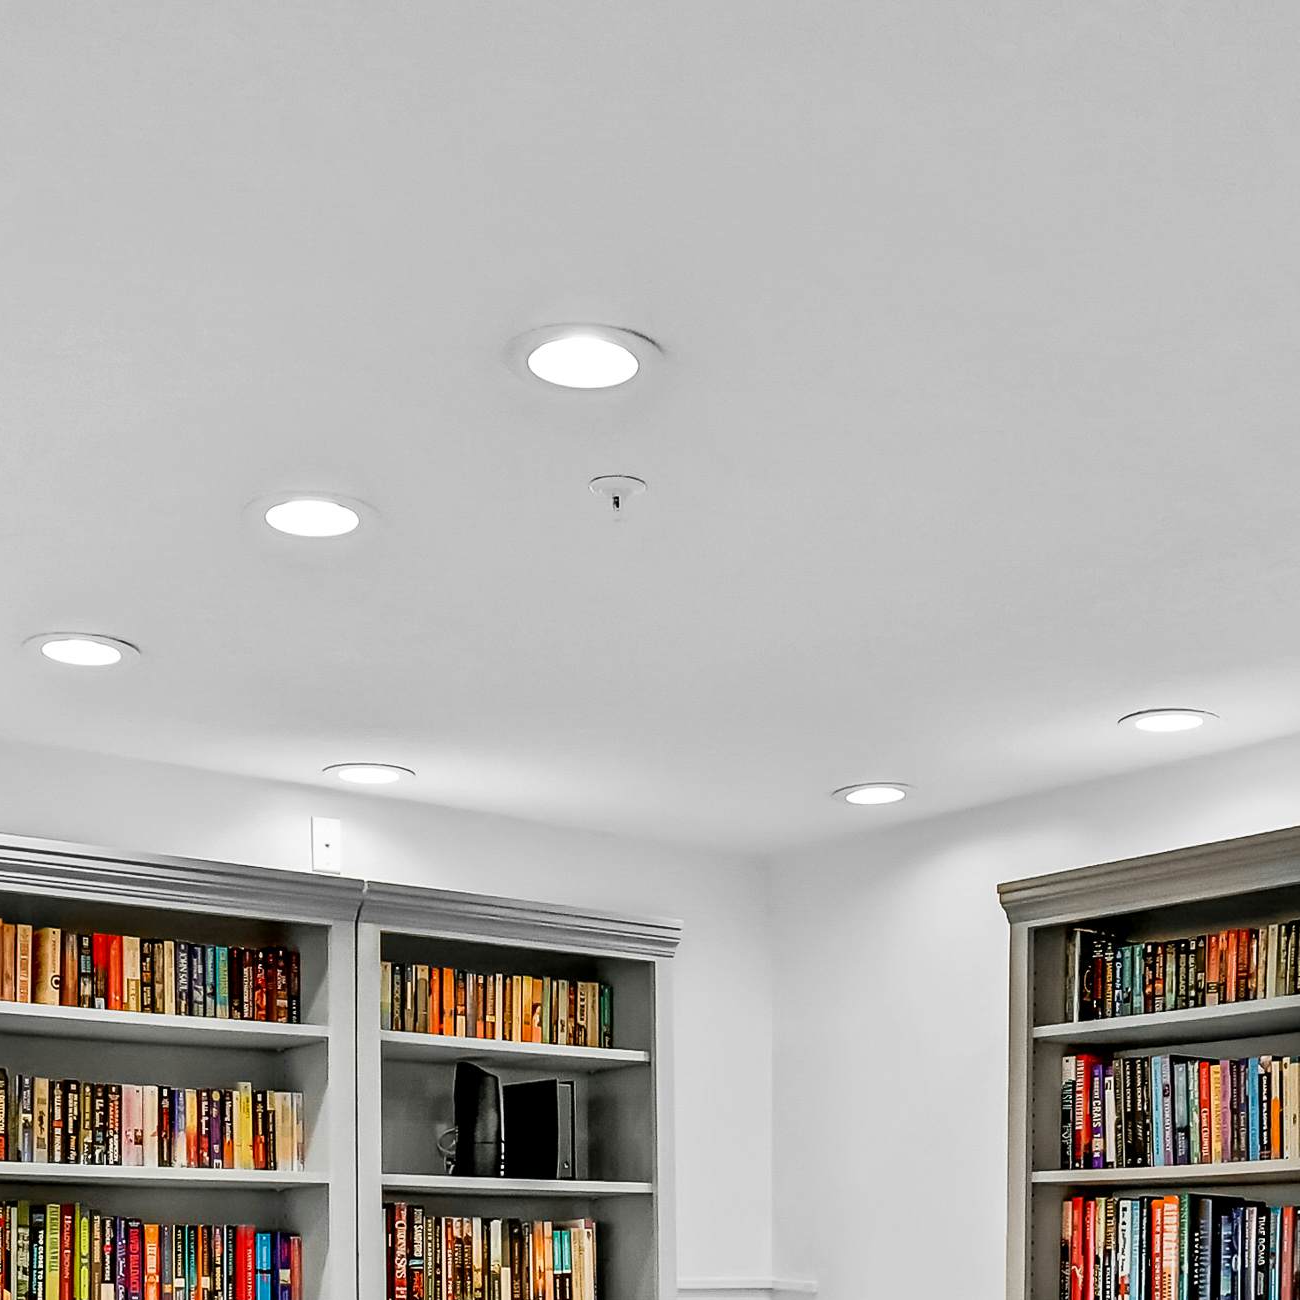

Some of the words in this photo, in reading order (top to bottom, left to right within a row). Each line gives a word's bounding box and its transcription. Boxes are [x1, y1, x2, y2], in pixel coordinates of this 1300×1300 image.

[1093, 1100, 1101, 1127] CRAIS
[1258, 1216, 1266, 1235] TIME
[414, 1225, 423, 1257] SANDFORD
